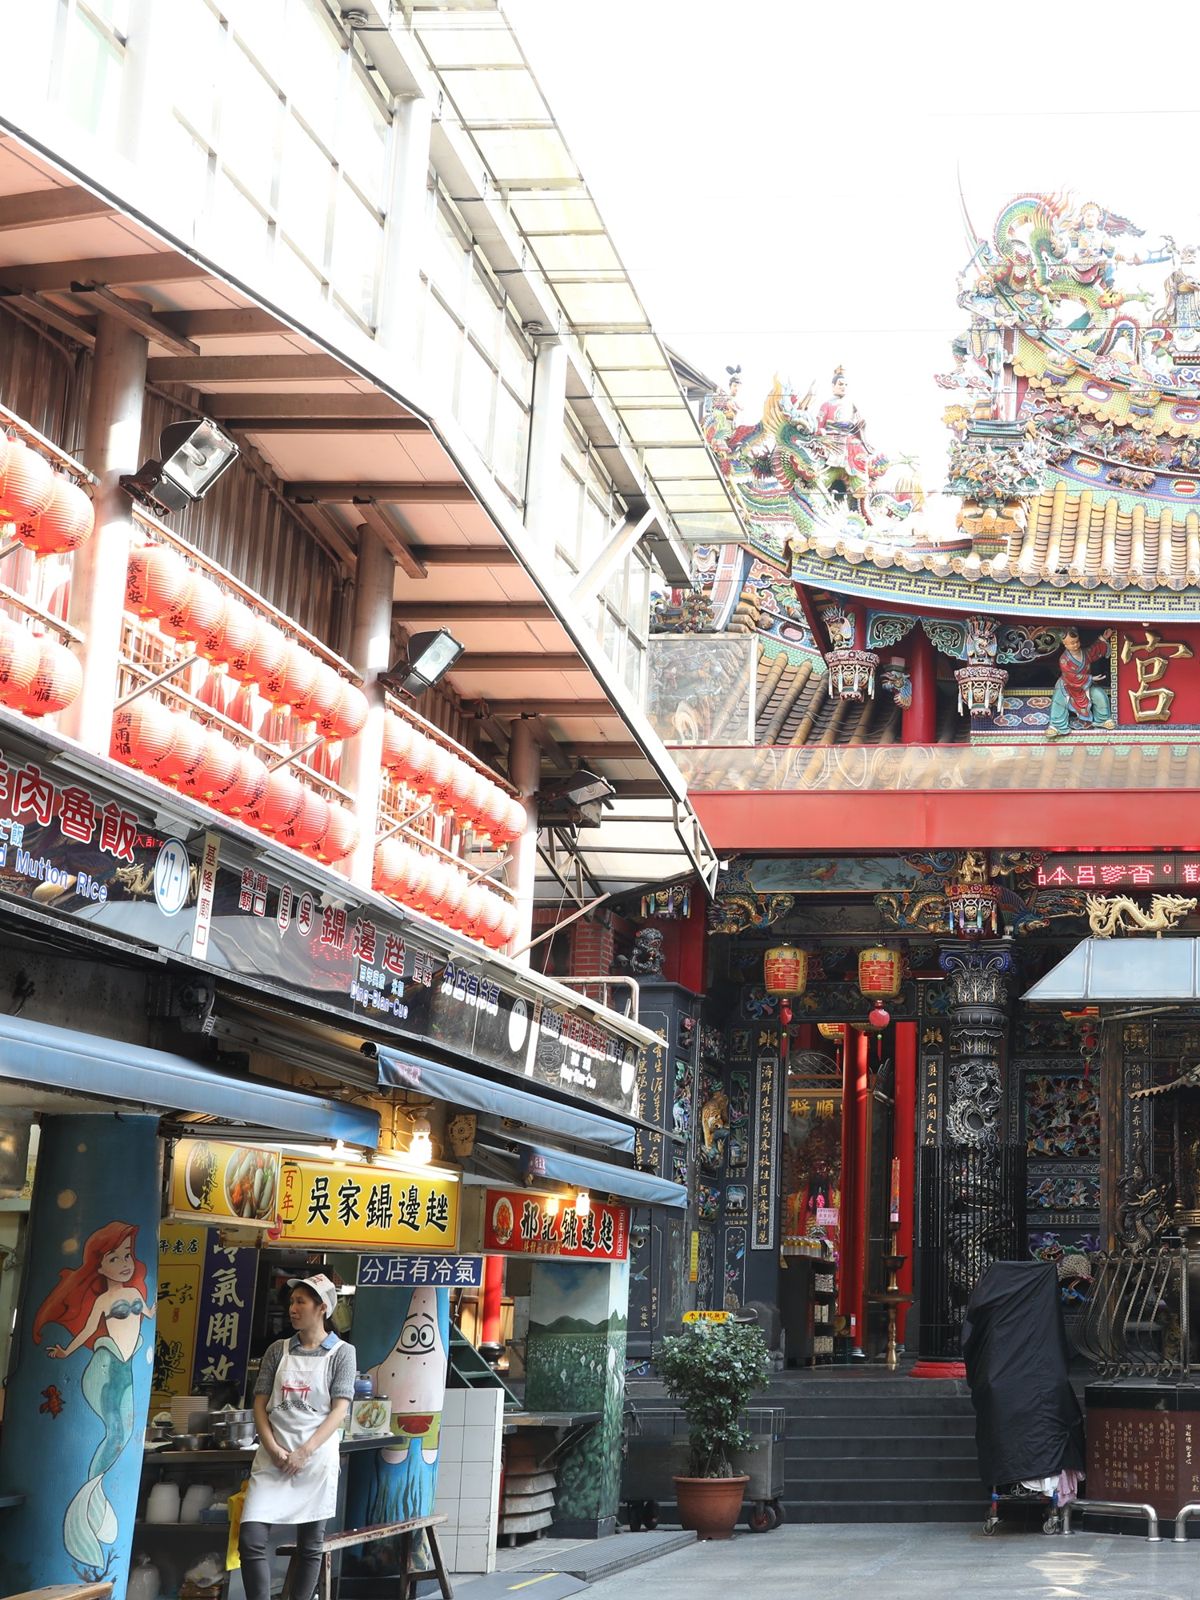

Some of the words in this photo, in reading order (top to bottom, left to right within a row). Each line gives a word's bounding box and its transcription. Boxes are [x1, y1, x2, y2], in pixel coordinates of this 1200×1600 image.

[0, 752, 138, 863] 肉魯飯
[15, 848, 70, 890] Mutton
[76, 871, 108, 903] Rice
[362, 1257, 476, 1285] 分店有冷氣
